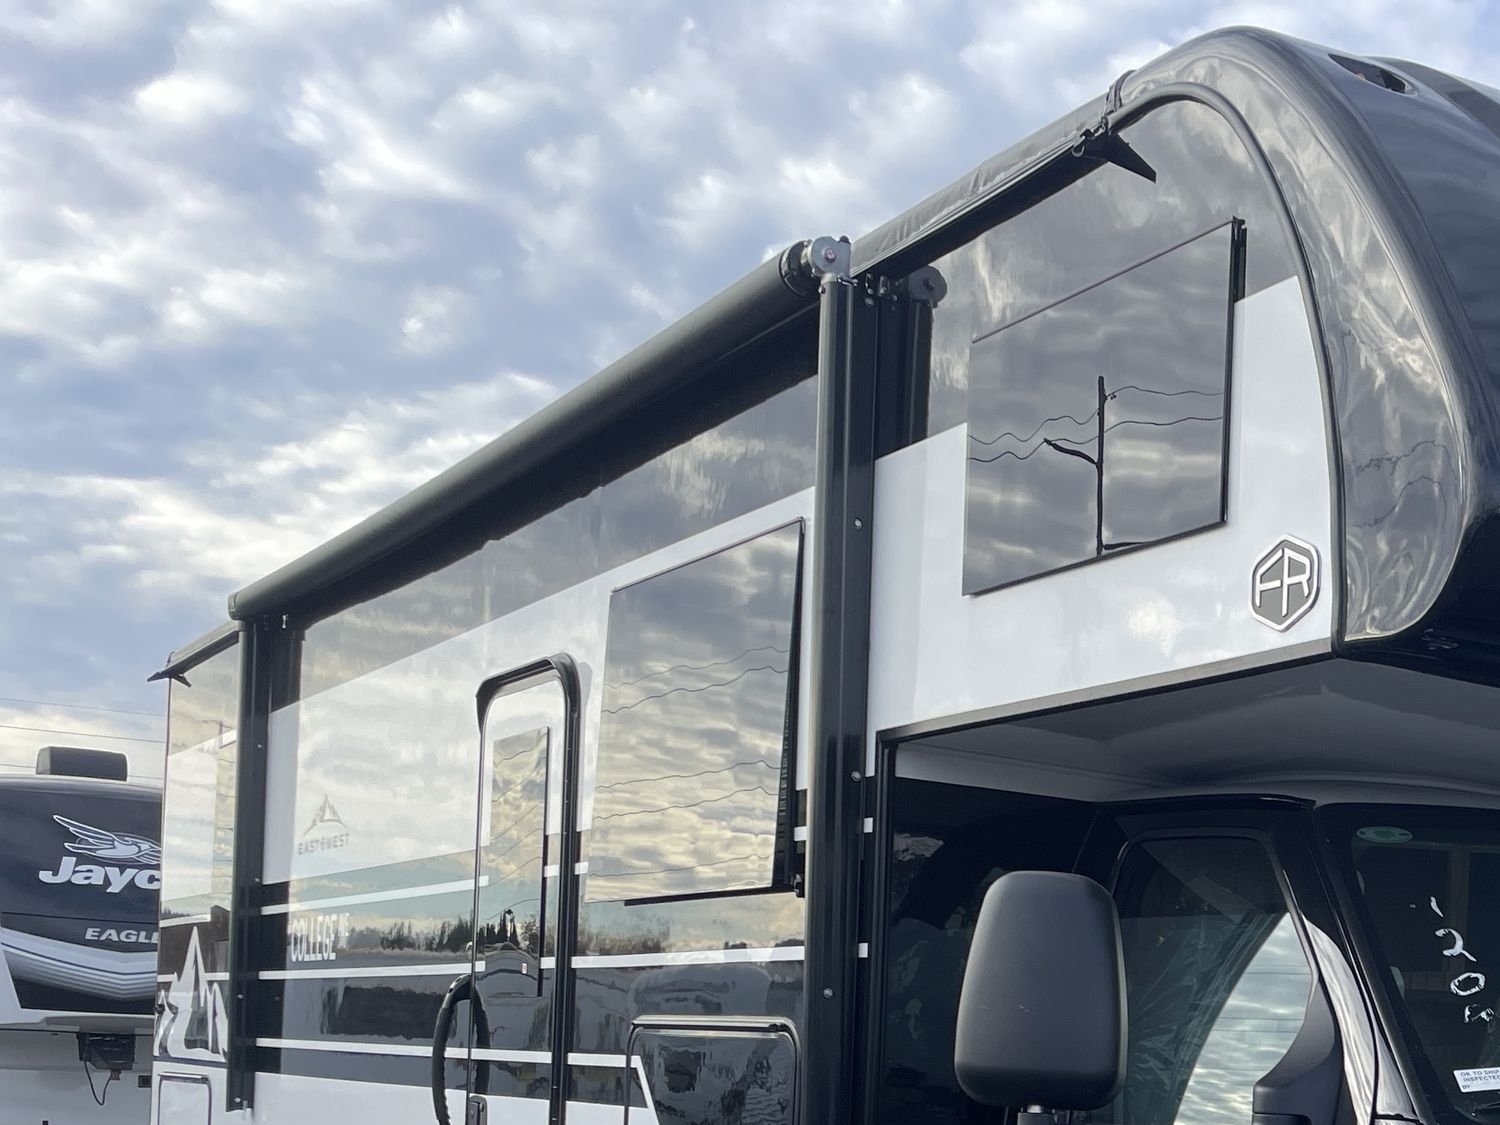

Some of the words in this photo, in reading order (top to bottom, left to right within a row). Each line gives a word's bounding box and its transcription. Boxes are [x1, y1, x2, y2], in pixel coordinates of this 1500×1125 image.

[298, 839, 320, 856] EAST
[326, 832, 350, 850] WEST
[291, 913, 338, 962] COLLEGE
